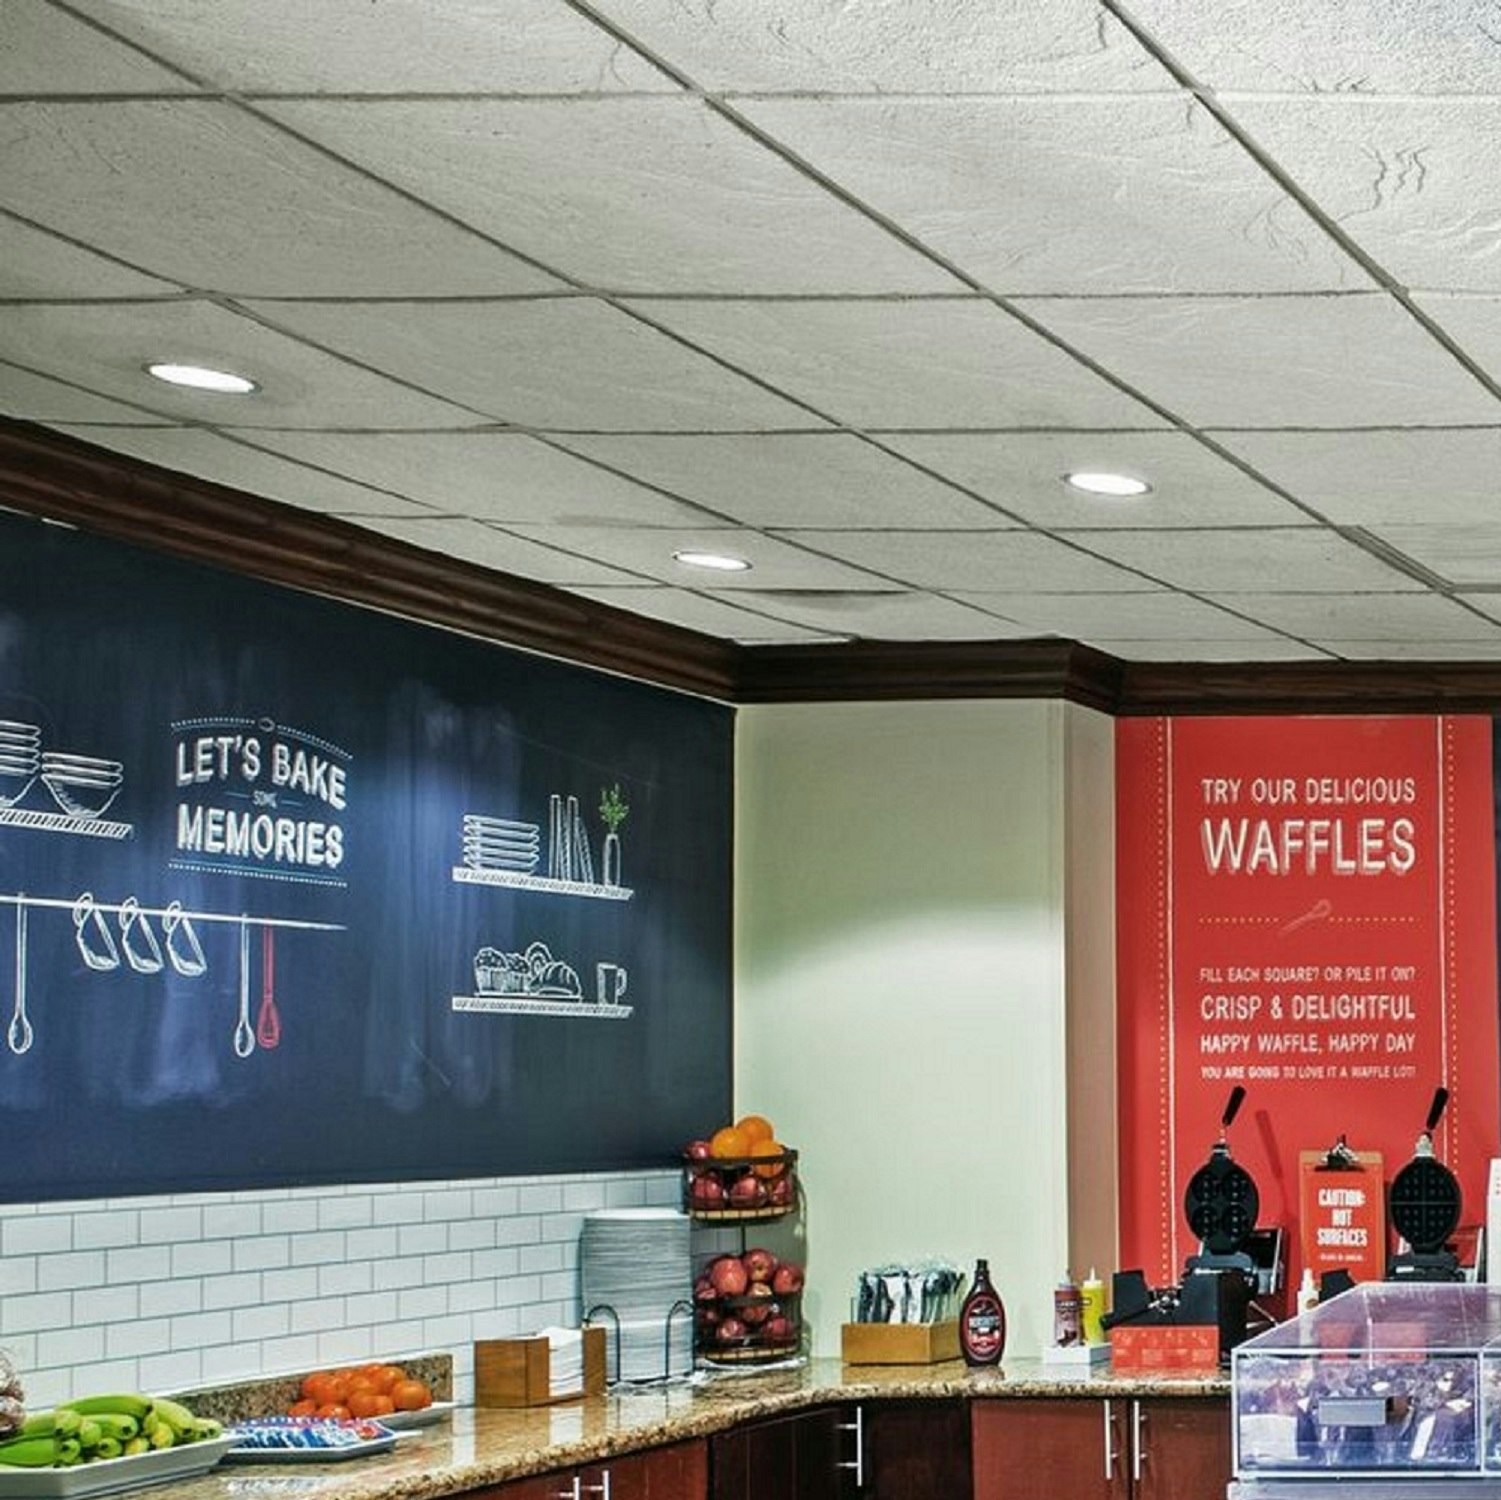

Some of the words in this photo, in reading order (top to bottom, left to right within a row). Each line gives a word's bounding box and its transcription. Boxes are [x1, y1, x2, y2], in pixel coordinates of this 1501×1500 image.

[177, 735, 261, 786] LET'S
[272, 743, 347, 810] BAKE
[1202, 778, 1241, 804] TRY
[1251, 778, 1296, 803] OUR
[1306, 776, 1416, 803] DELICIOUS
[177, 803, 343, 869] MEMORIES
[1202, 818, 1416, 875] WAFFLES
[1200, 967, 1223, 983] FILL
[1228, 967, 1260, 982] EACH
[1264, 967, 1319, 982] SQUARE?
[1324, 967, 1342, 981] OR
[1346, 967, 1372, 981] PILE
[1376, 967, 1386, 981] IT
[1201, 995, 1262, 1020] CRISP
[1270, 995, 1283, 1020] &
[1292, 995, 1416, 1020] DELIGHTFUL
[1200, 1034, 1250, 1053] HAPPY
[1257, 1033, 1322, 1055] WAFFLE,
[1329, 1033, 1379, 1052] HAPPY
[1386, 1033, 1415, 1052] DAY
[1201, 1066, 1221, 1079] YOU
[1225, 1066, 1245, 1079] ARE
[1248, 1066, 1280, 1079] GOING
[1283, 1066, 1297, 1079] TO
[1300, 1066, 1325, 1079] LOVE
[1327, 1066, 1336, 1078] IT
[1339, 1066, 1348, 1078] A
[1351, 1066, 1391, 1079] WAFFLE
